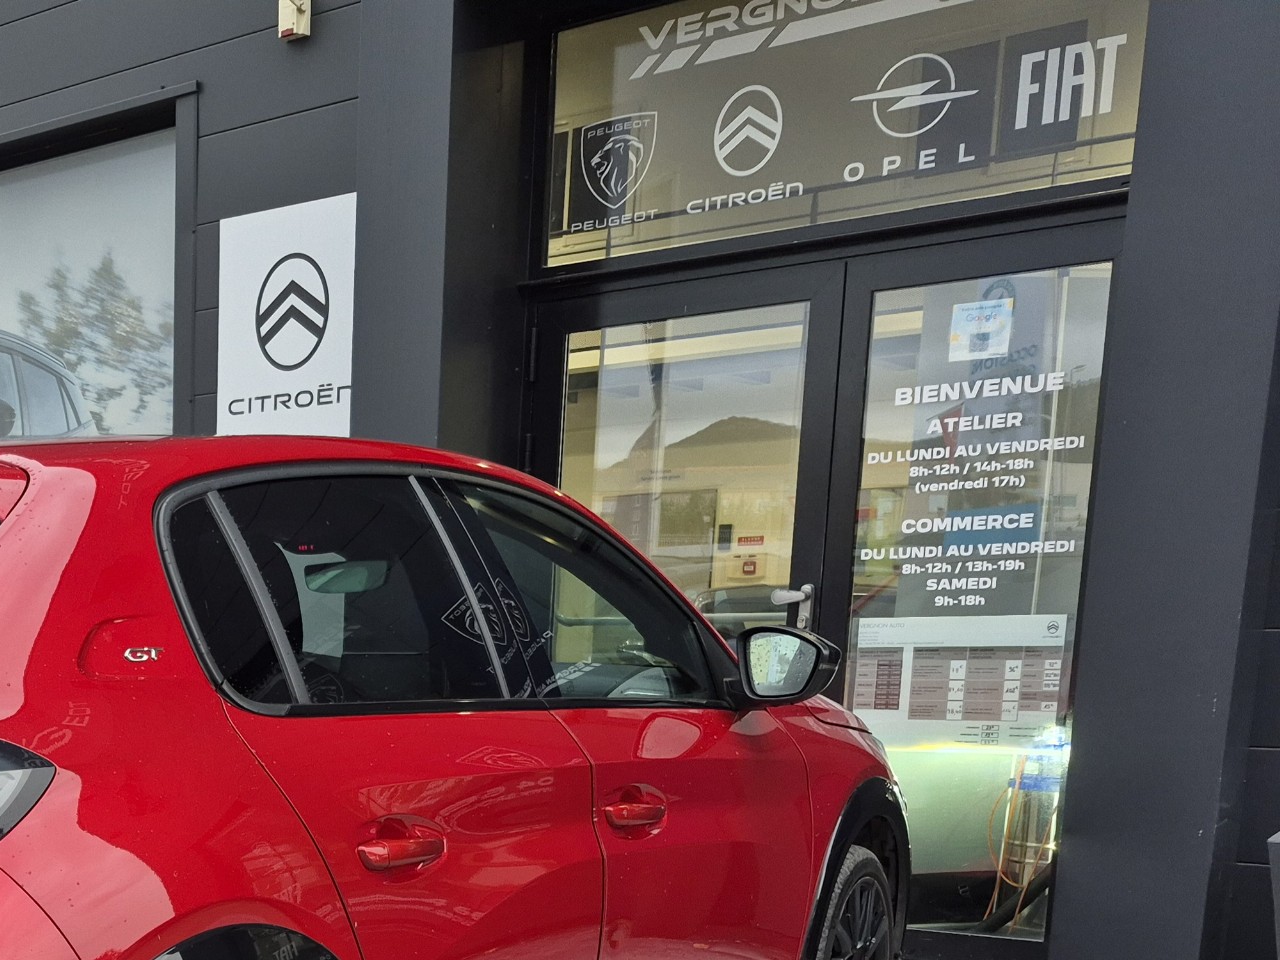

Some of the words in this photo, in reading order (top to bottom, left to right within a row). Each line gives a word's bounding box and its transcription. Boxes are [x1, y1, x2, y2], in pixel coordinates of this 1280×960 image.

[638, 0, 857, 50] VERGN
[1015, 34, 1127, 130] FIAT
[587, 119, 651, 139] PEUGEOT
[843, 143, 975, 182] OPEL
[571, 209, 658, 233] PEUGEOT
[894, 372, 1065, 406] BIENVENUE
[927, 412, 1023, 434] ATELIER
[867, 451, 893, 465] DU
[896, 447, 950, 463] LUNDI
[954, 444, 982, 459] AU
[986, 435, 1085, 456] VENDREDI
[909, 462, 960, 477] 8h-12h
[974, 458, 1034, 473] 14h-18h
[915, 477, 988, 494] (vendredi
[992, 475, 1026, 490] 17h)
[901, 513, 1035, 534] COMMERCE
[860, 548, 886, 561] DU
[889, 545, 943, 560] LUNDI
[946, 543, 973, 557] AU
[977, 540, 1076, 556] VENDREDI
[902, 562, 952, 575] 8h-12h
[965, 559, 1025, 573] 13h-19h
[926, 576, 997, 591] SAMEDI
[934, 594, 986, 606] 9h-18h
[124, 647, 164, 662] GT
